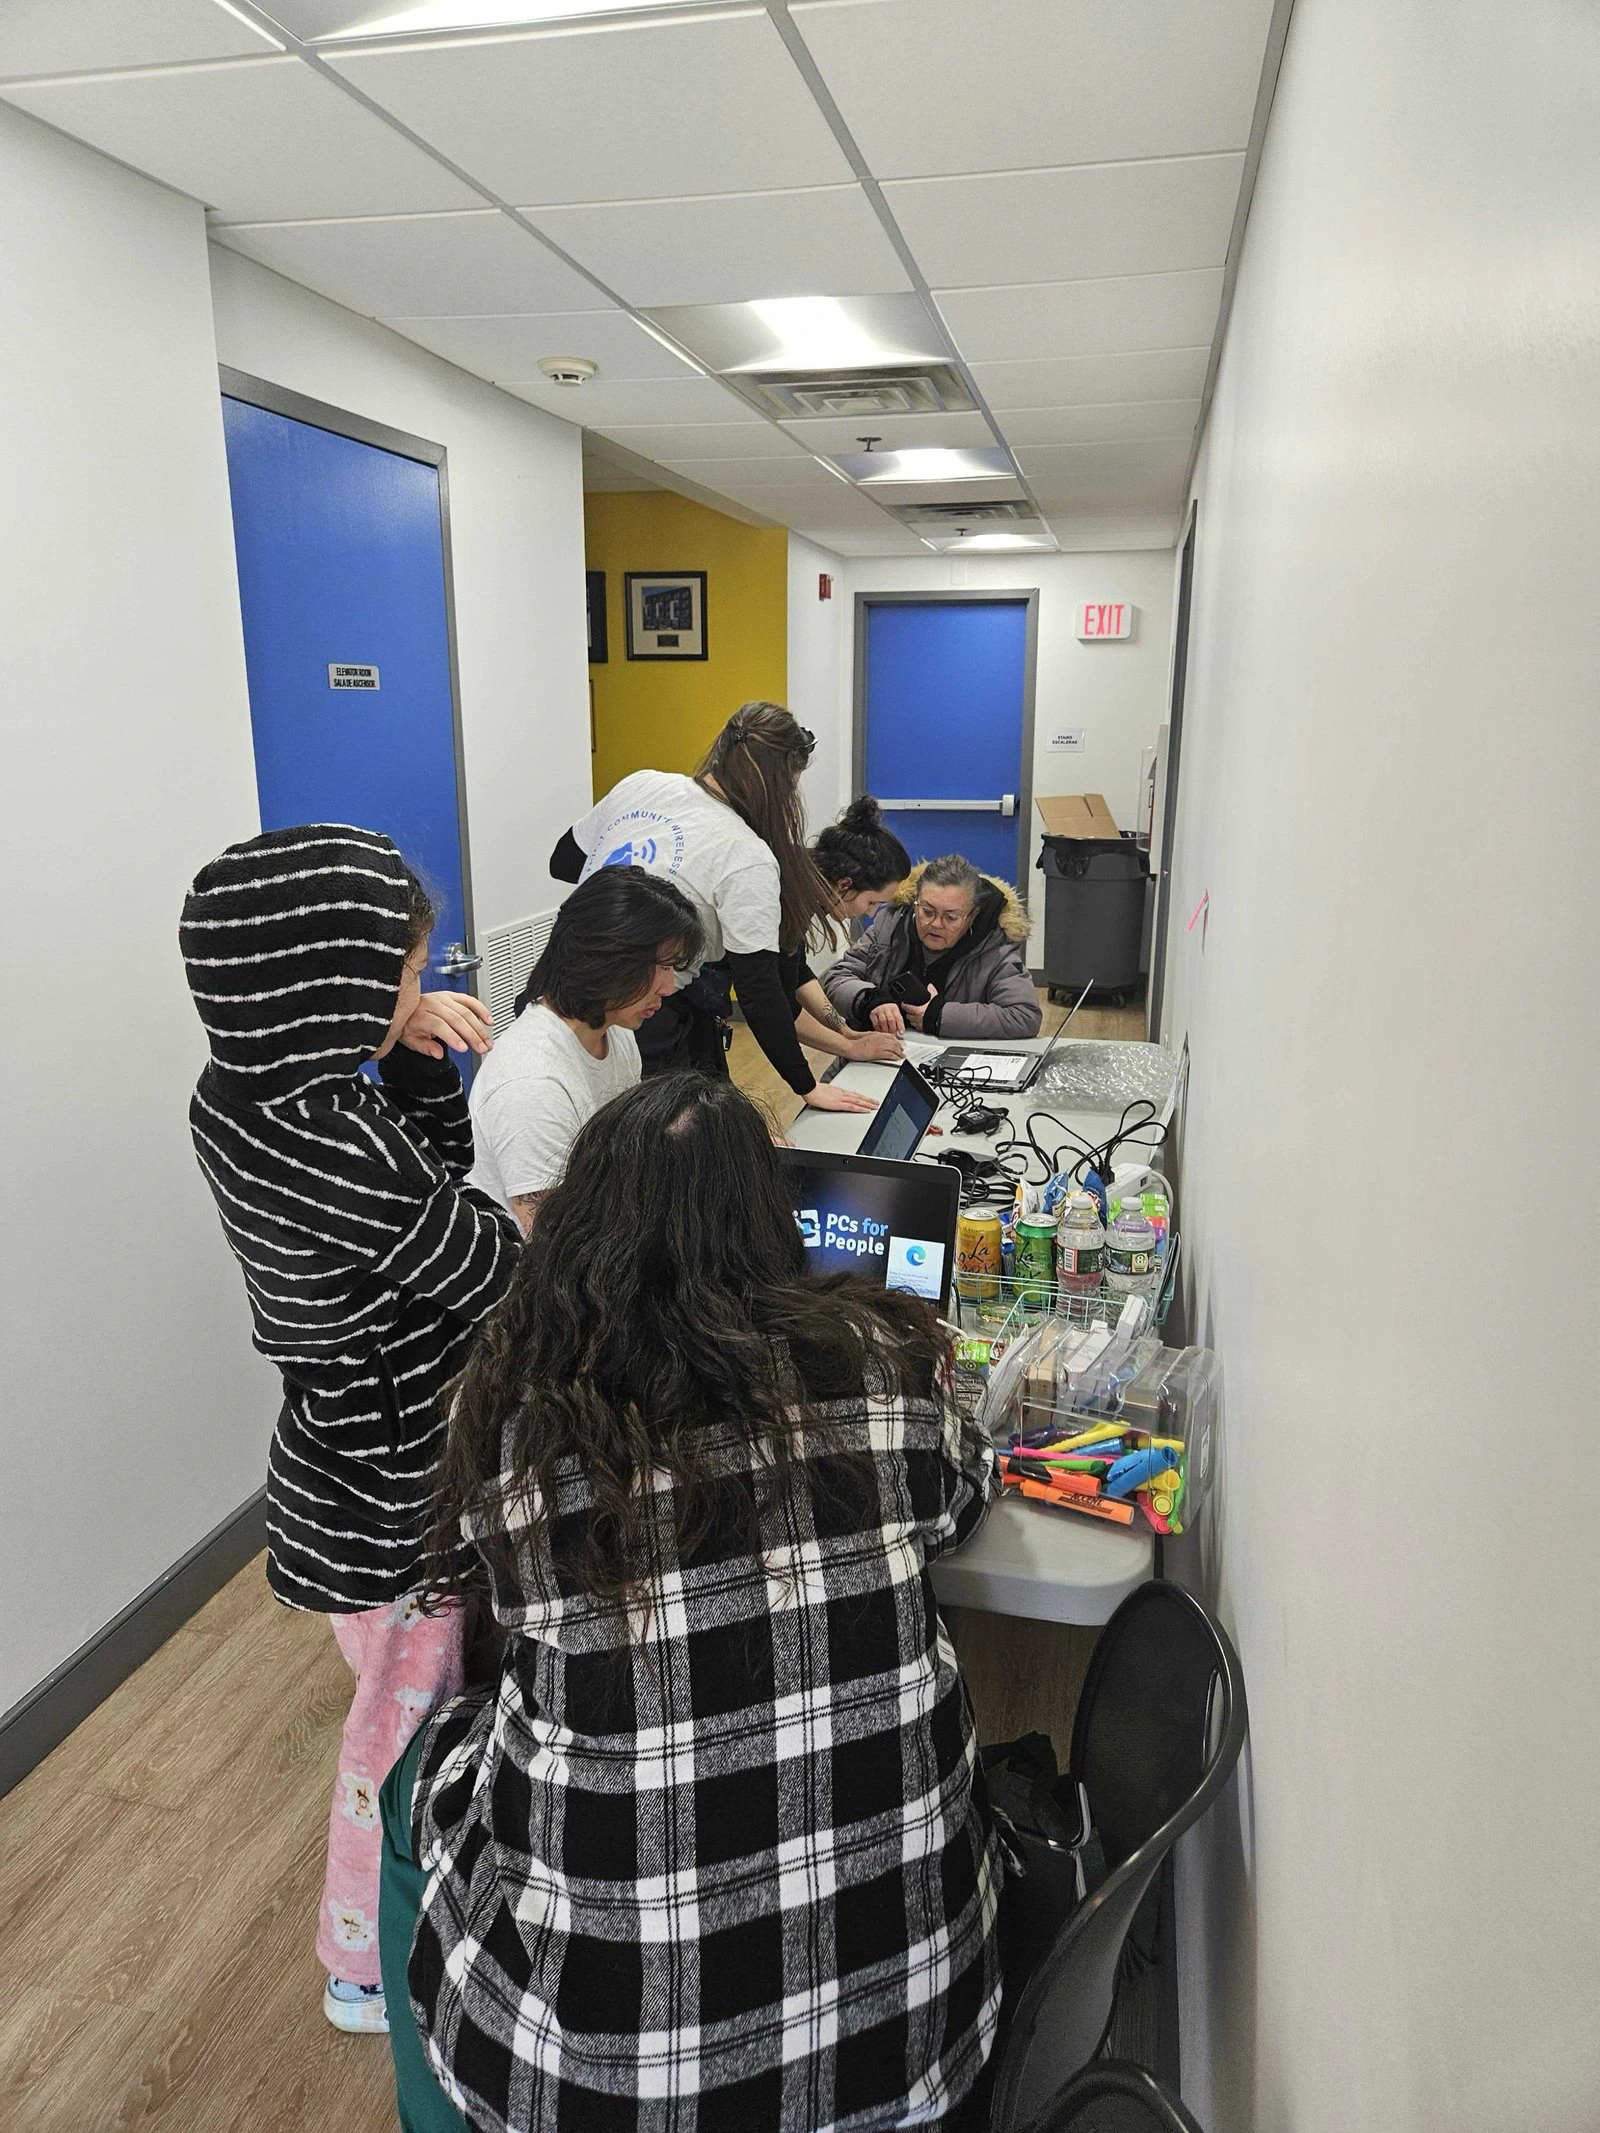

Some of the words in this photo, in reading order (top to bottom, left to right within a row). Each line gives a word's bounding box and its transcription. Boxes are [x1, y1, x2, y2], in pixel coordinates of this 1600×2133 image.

[1084, 604, 1125, 635] EXIT
[333, 679, 346, 687] SALA
[336, 667, 358, 677] ELEVATOR
[607, 810, 672, 831] COMMUNITY
[669, 824, 685, 876] WIRELESS
[826, 1213, 859, 1233] PCs
[862, 1217, 889, 1237] for
[824, 1231, 885, 1256] People
[967, 1236, 990, 1262] La
